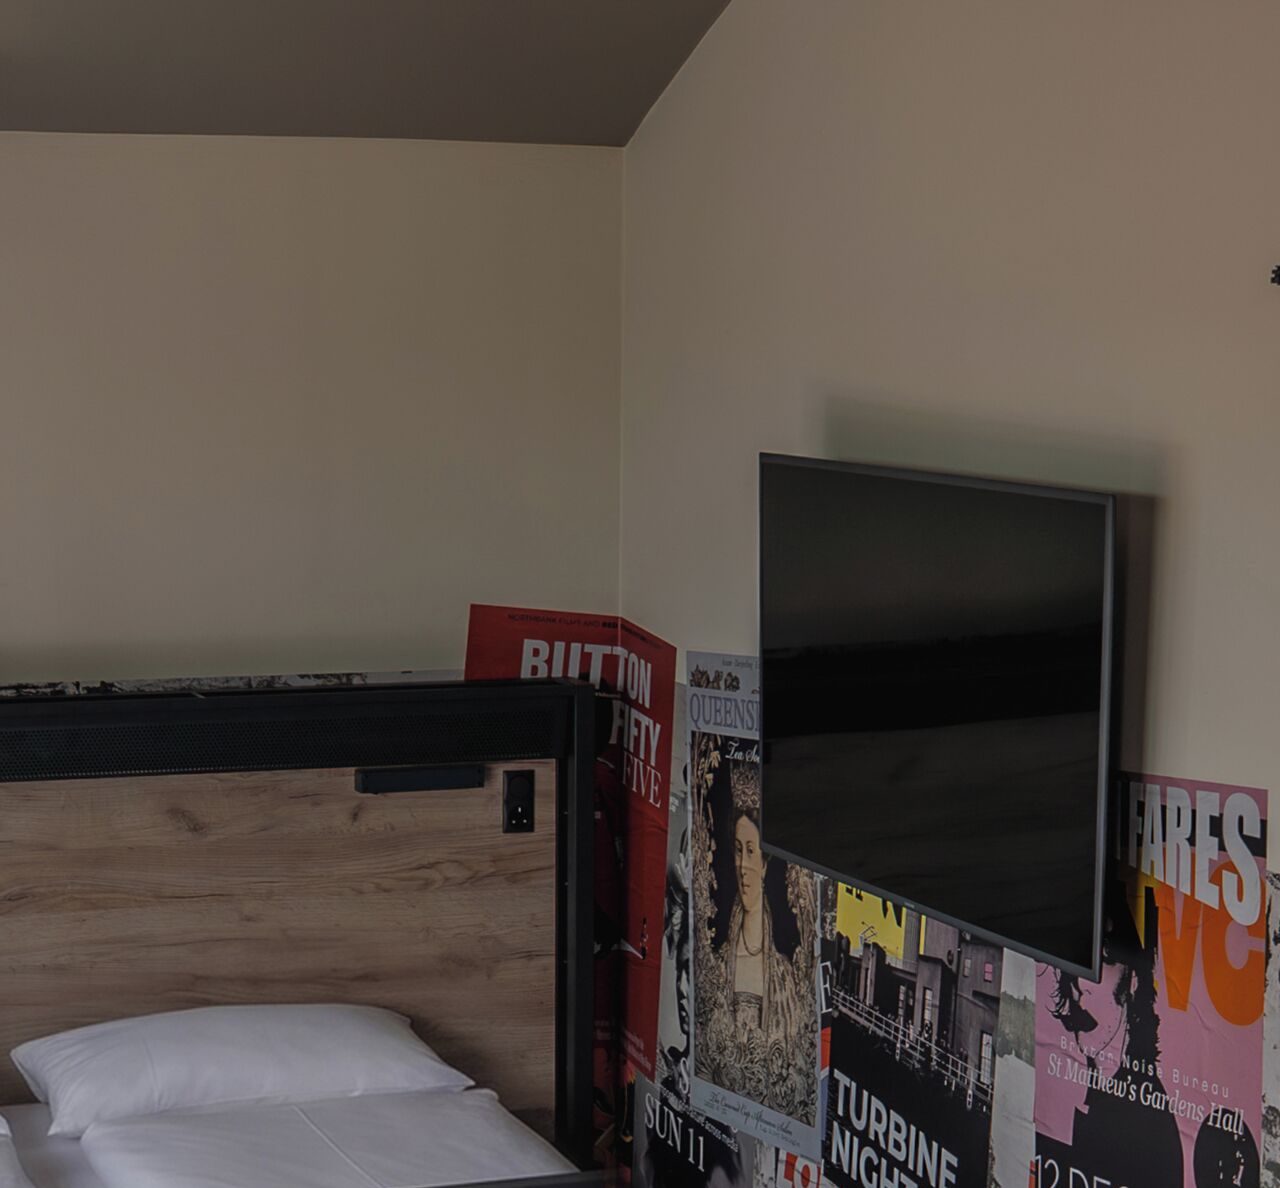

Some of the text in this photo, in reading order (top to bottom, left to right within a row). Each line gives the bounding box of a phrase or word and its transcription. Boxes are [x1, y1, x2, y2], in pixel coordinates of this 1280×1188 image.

[521, 638, 652, 709] BUTTON
[608, 699, 661, 767] FIFTY
[622, 751, 662, 809] FIVE
[1128, 779, 1261, 927] FARES
[1047, 1052, 1245, 1137] St Matthew's Gardens Hall
[1122, 1054, 1163, 1079] Noise
[1172, 1068, 1230, 1099] Bureau
[645, 1091, 683, 1154] SUN
